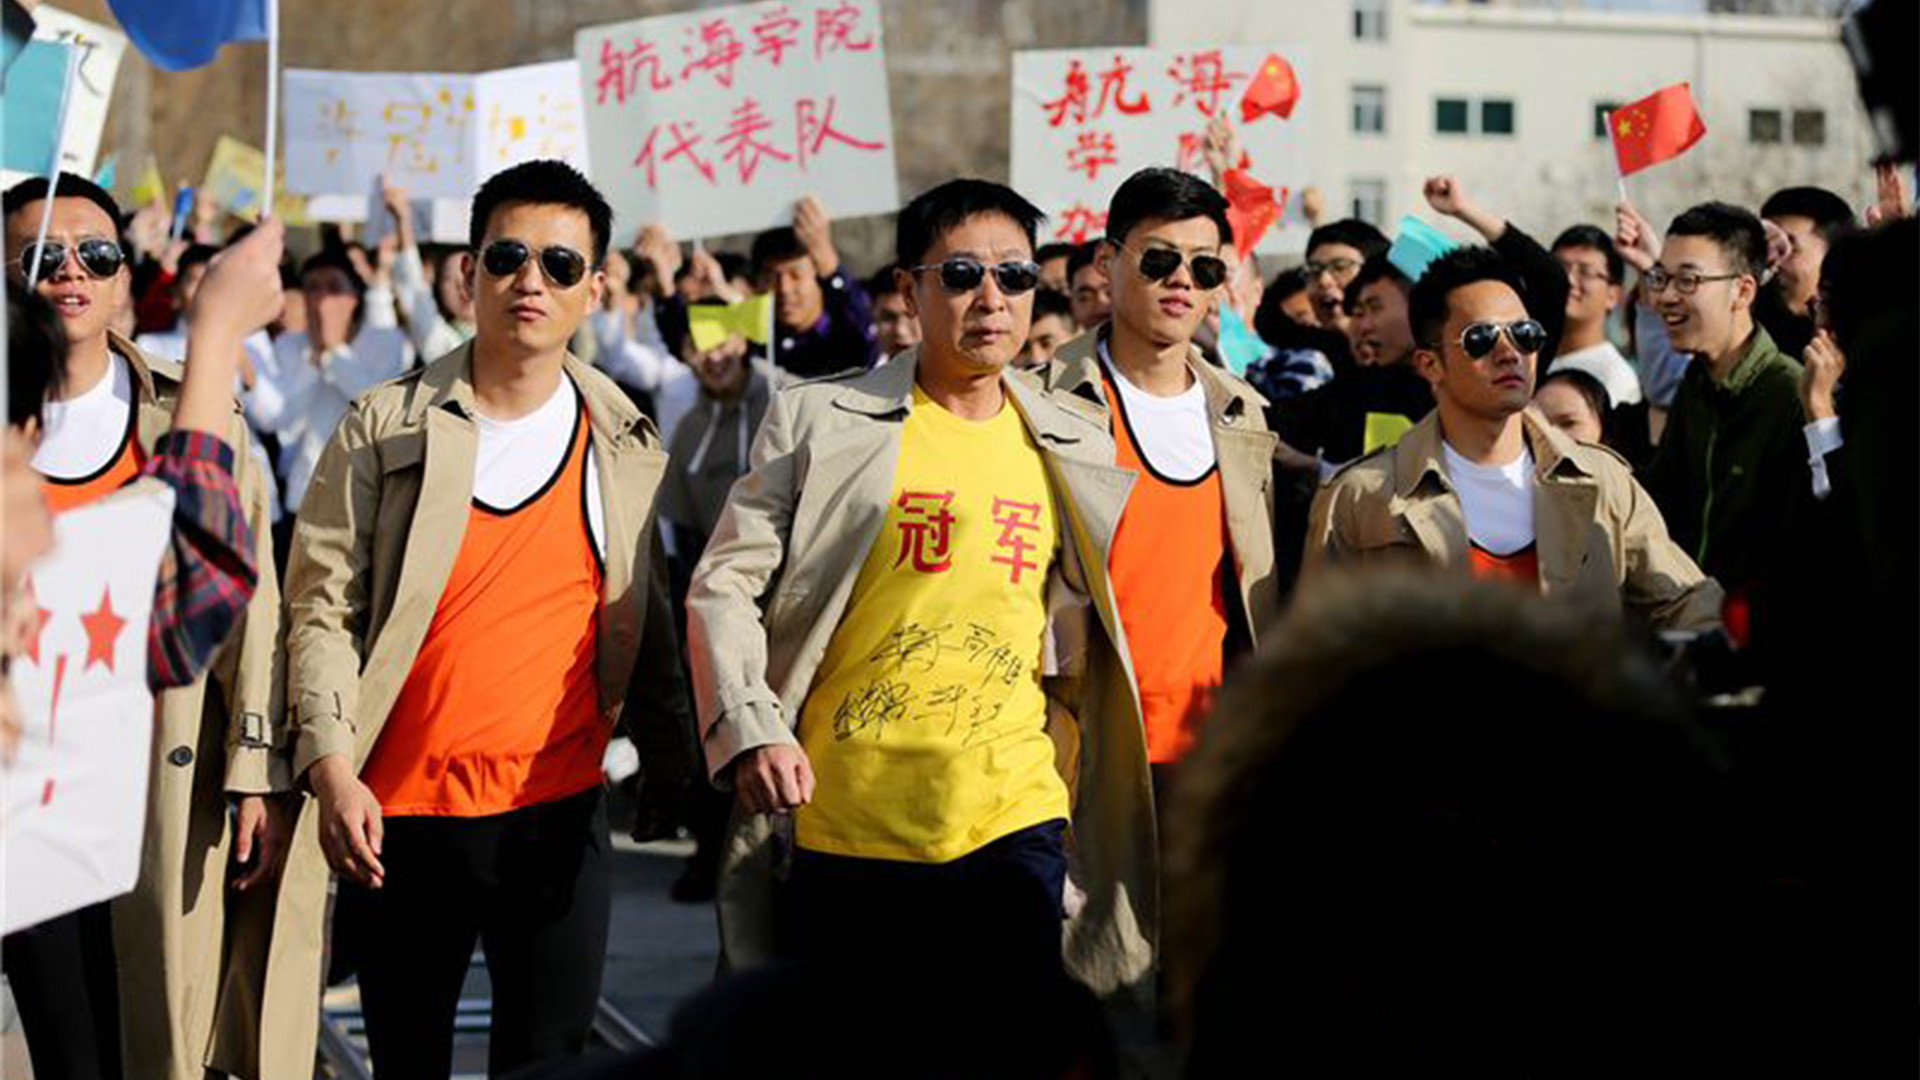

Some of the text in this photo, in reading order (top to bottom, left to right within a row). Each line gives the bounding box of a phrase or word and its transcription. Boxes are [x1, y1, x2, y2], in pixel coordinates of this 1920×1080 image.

[596, 2, 873, 106] 航海学院
[1042, 50, 1248, 127] 航海
[634, 96, 885, 188] 代表队
[893, 487, 1041, 585] 冠军
